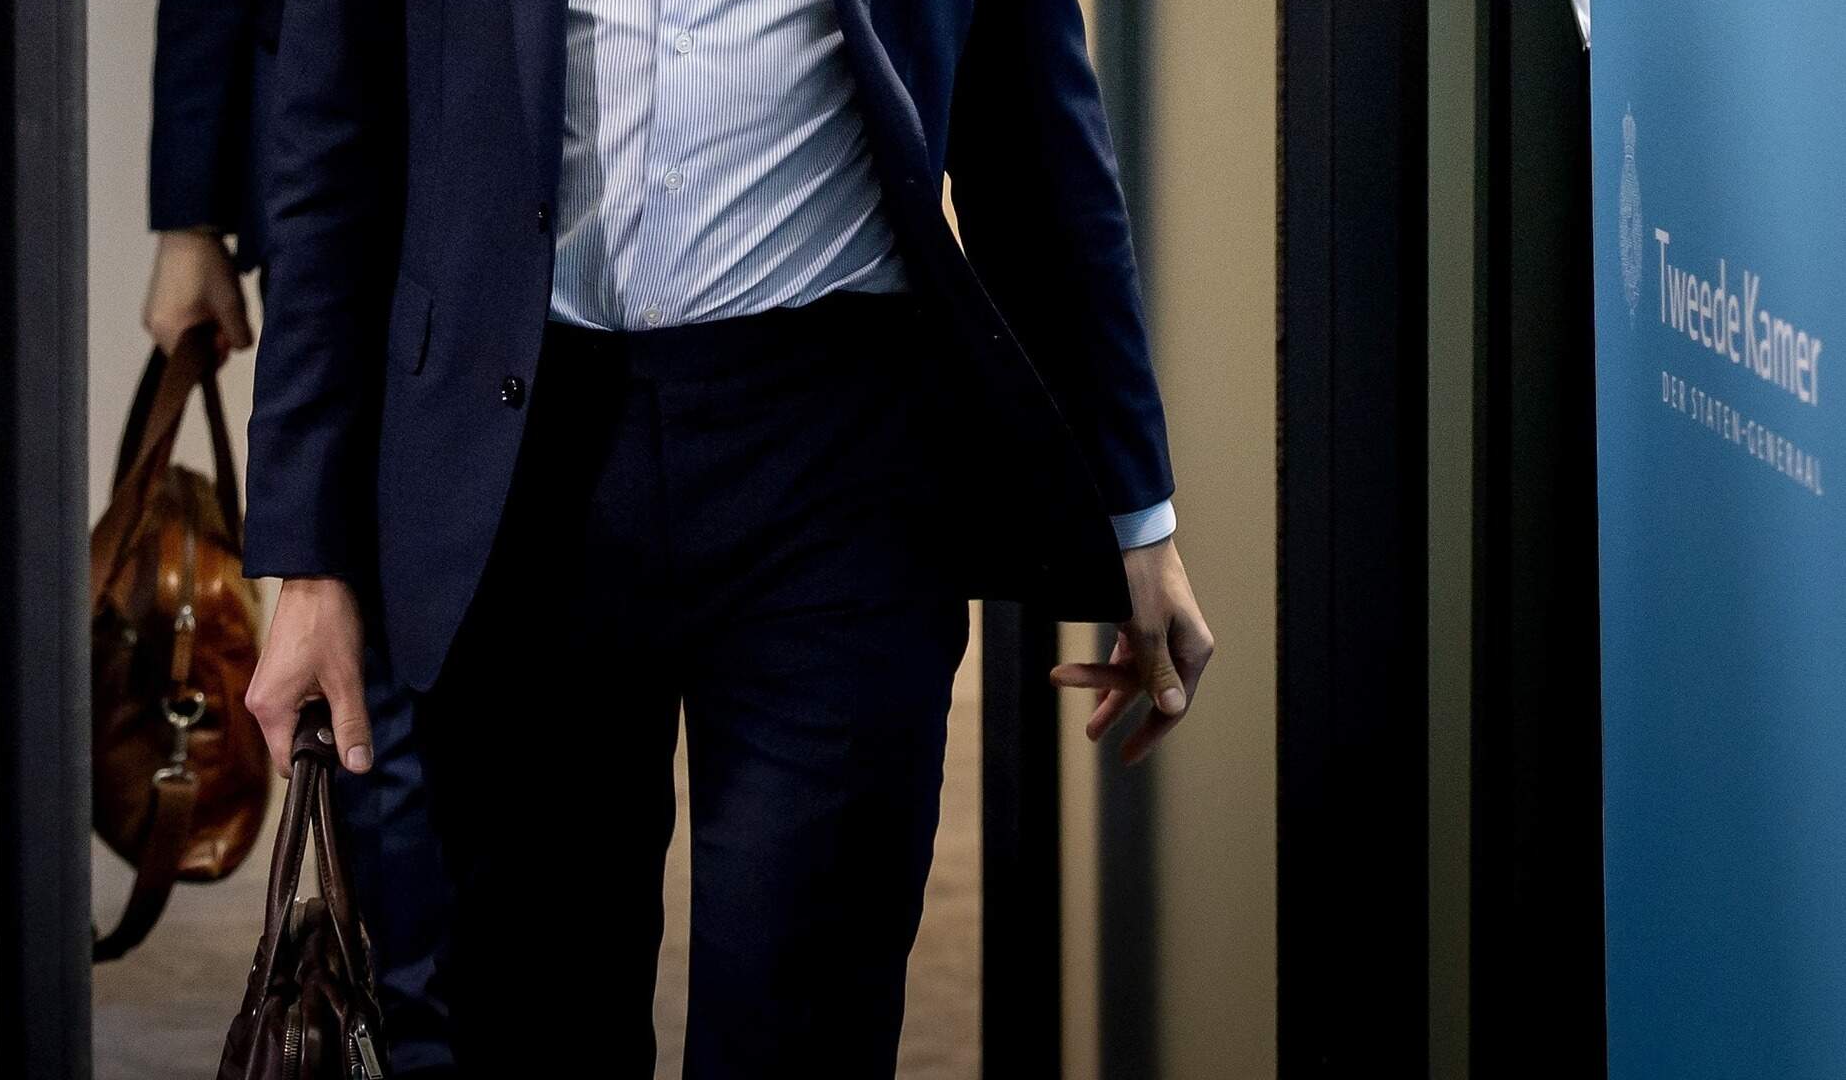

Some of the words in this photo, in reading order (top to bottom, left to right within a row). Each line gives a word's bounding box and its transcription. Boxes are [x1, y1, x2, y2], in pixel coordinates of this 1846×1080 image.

[1655, 228, 1740, 364] Tweede
[1744, 270, 1822, 407] Kamer
[1662, 371, 1686, 413] DER
[1691, 386, 1822, 496] STATEN-GENERAAL
